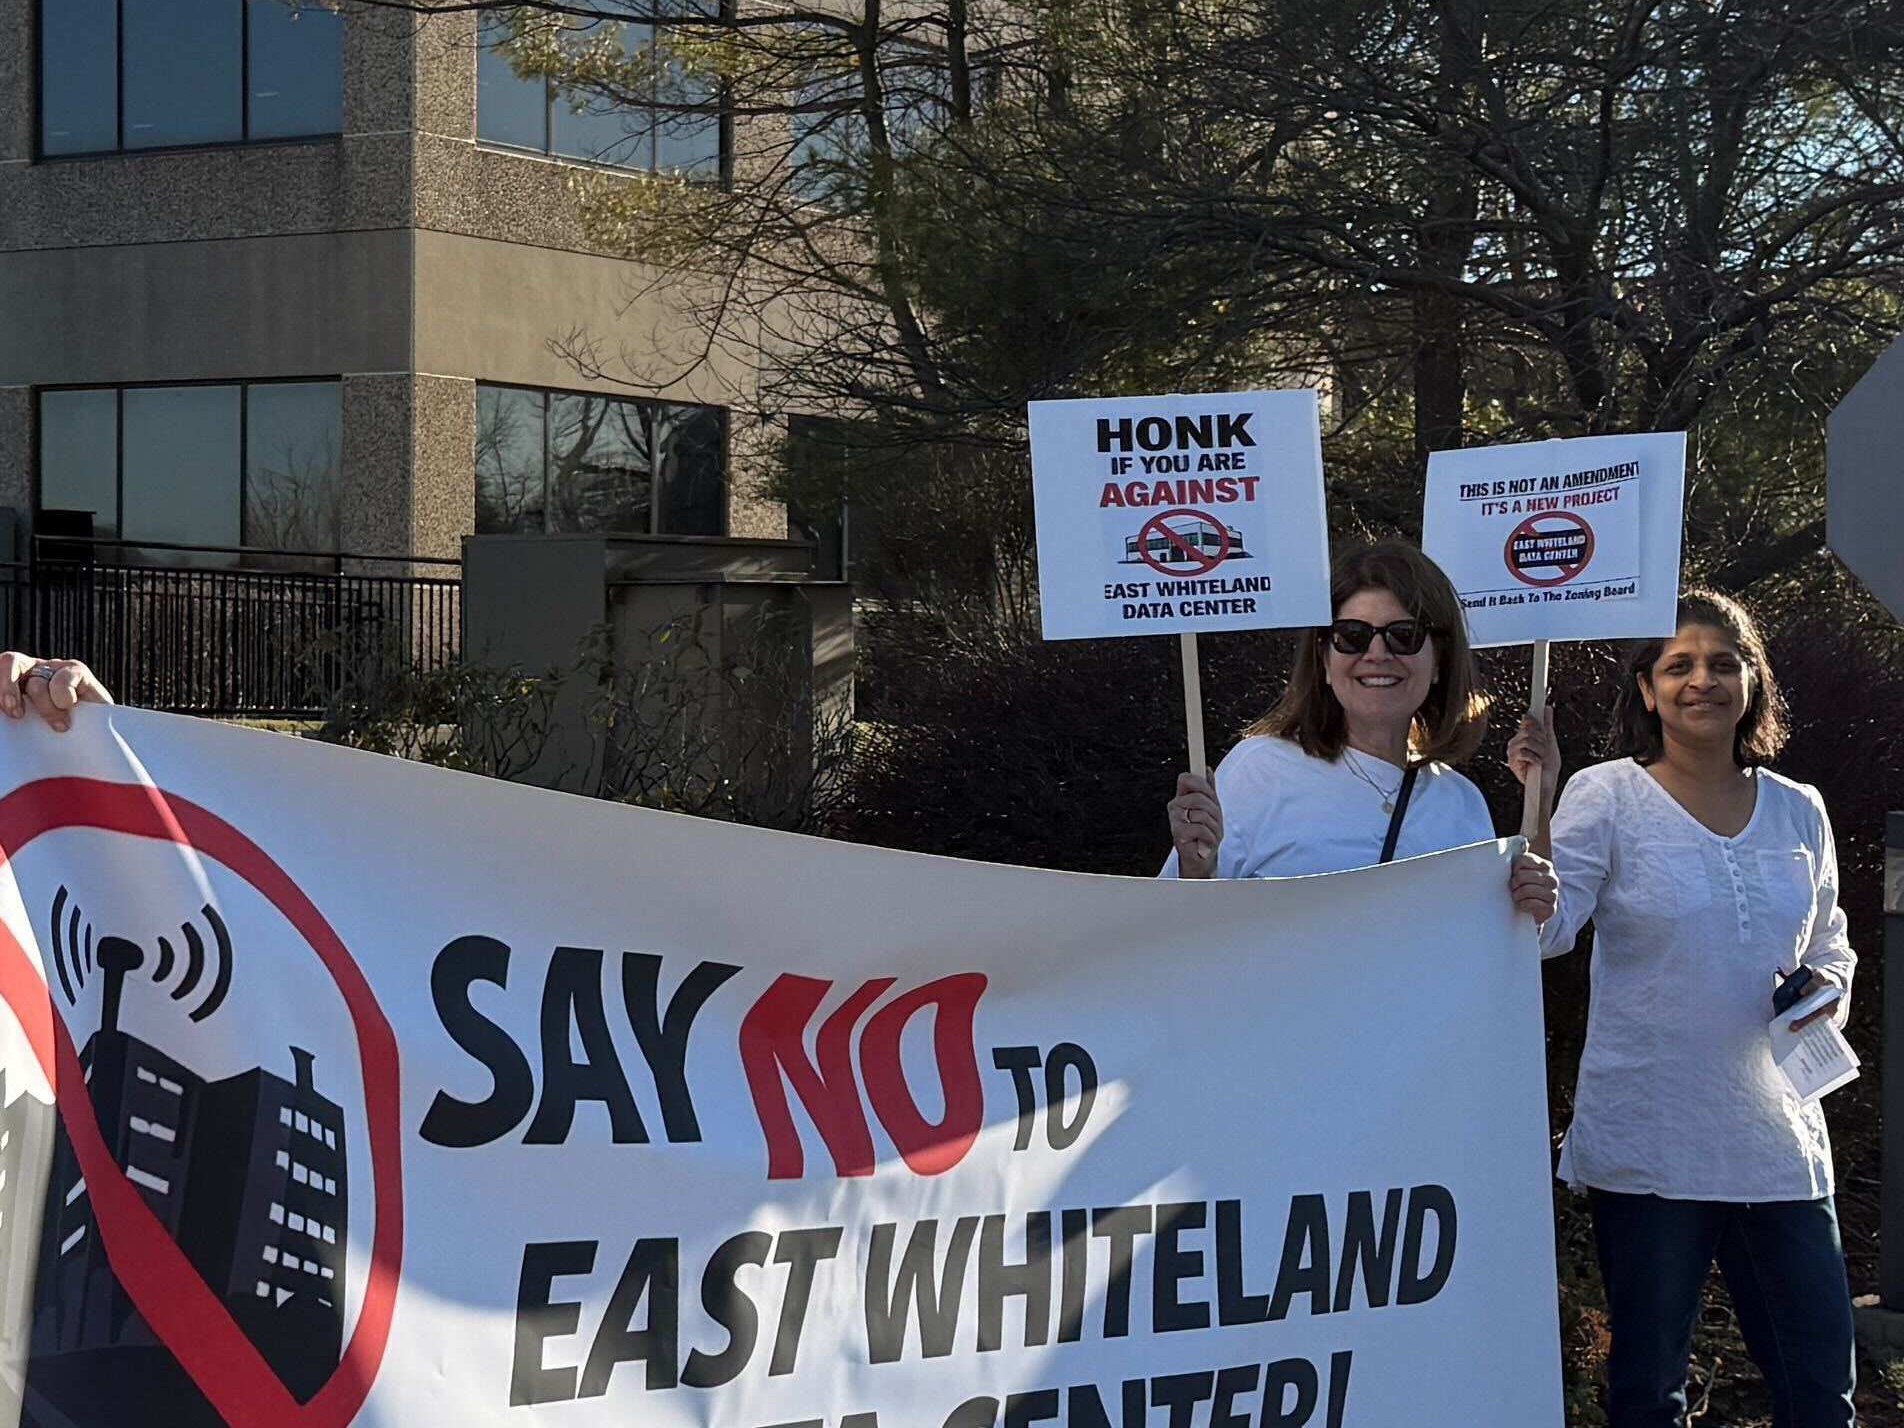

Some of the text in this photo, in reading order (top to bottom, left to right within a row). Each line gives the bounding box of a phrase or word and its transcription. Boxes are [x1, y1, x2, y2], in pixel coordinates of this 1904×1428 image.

[1096, 412, 1257, 453] HONK
[1110, 452, 1246, 475] IF YOU ARE
[1099, 476, 1260, 508] AGAINST
[1460, 482, 1489, 498] THIS
[1492, 480, 1506, 496] IS
[1508, 477, 1537, 493] NOT
[1539, 475, 1559, 491] AN
[1481, 486, 1621, 516] IT'S A NEW PROJECT
[1104, 576, 1271, 600] EAST WHITELAND
[1565, 586, 1601, 601] Zoning
[1603, 581, 1636, 597] Board
[1122, 598, 1257, 620] DATA CENTER
[418, 934, 1099, 1180] SAY NO TO
[509, 1183, 1458, 1408] EAST WHITELAND
